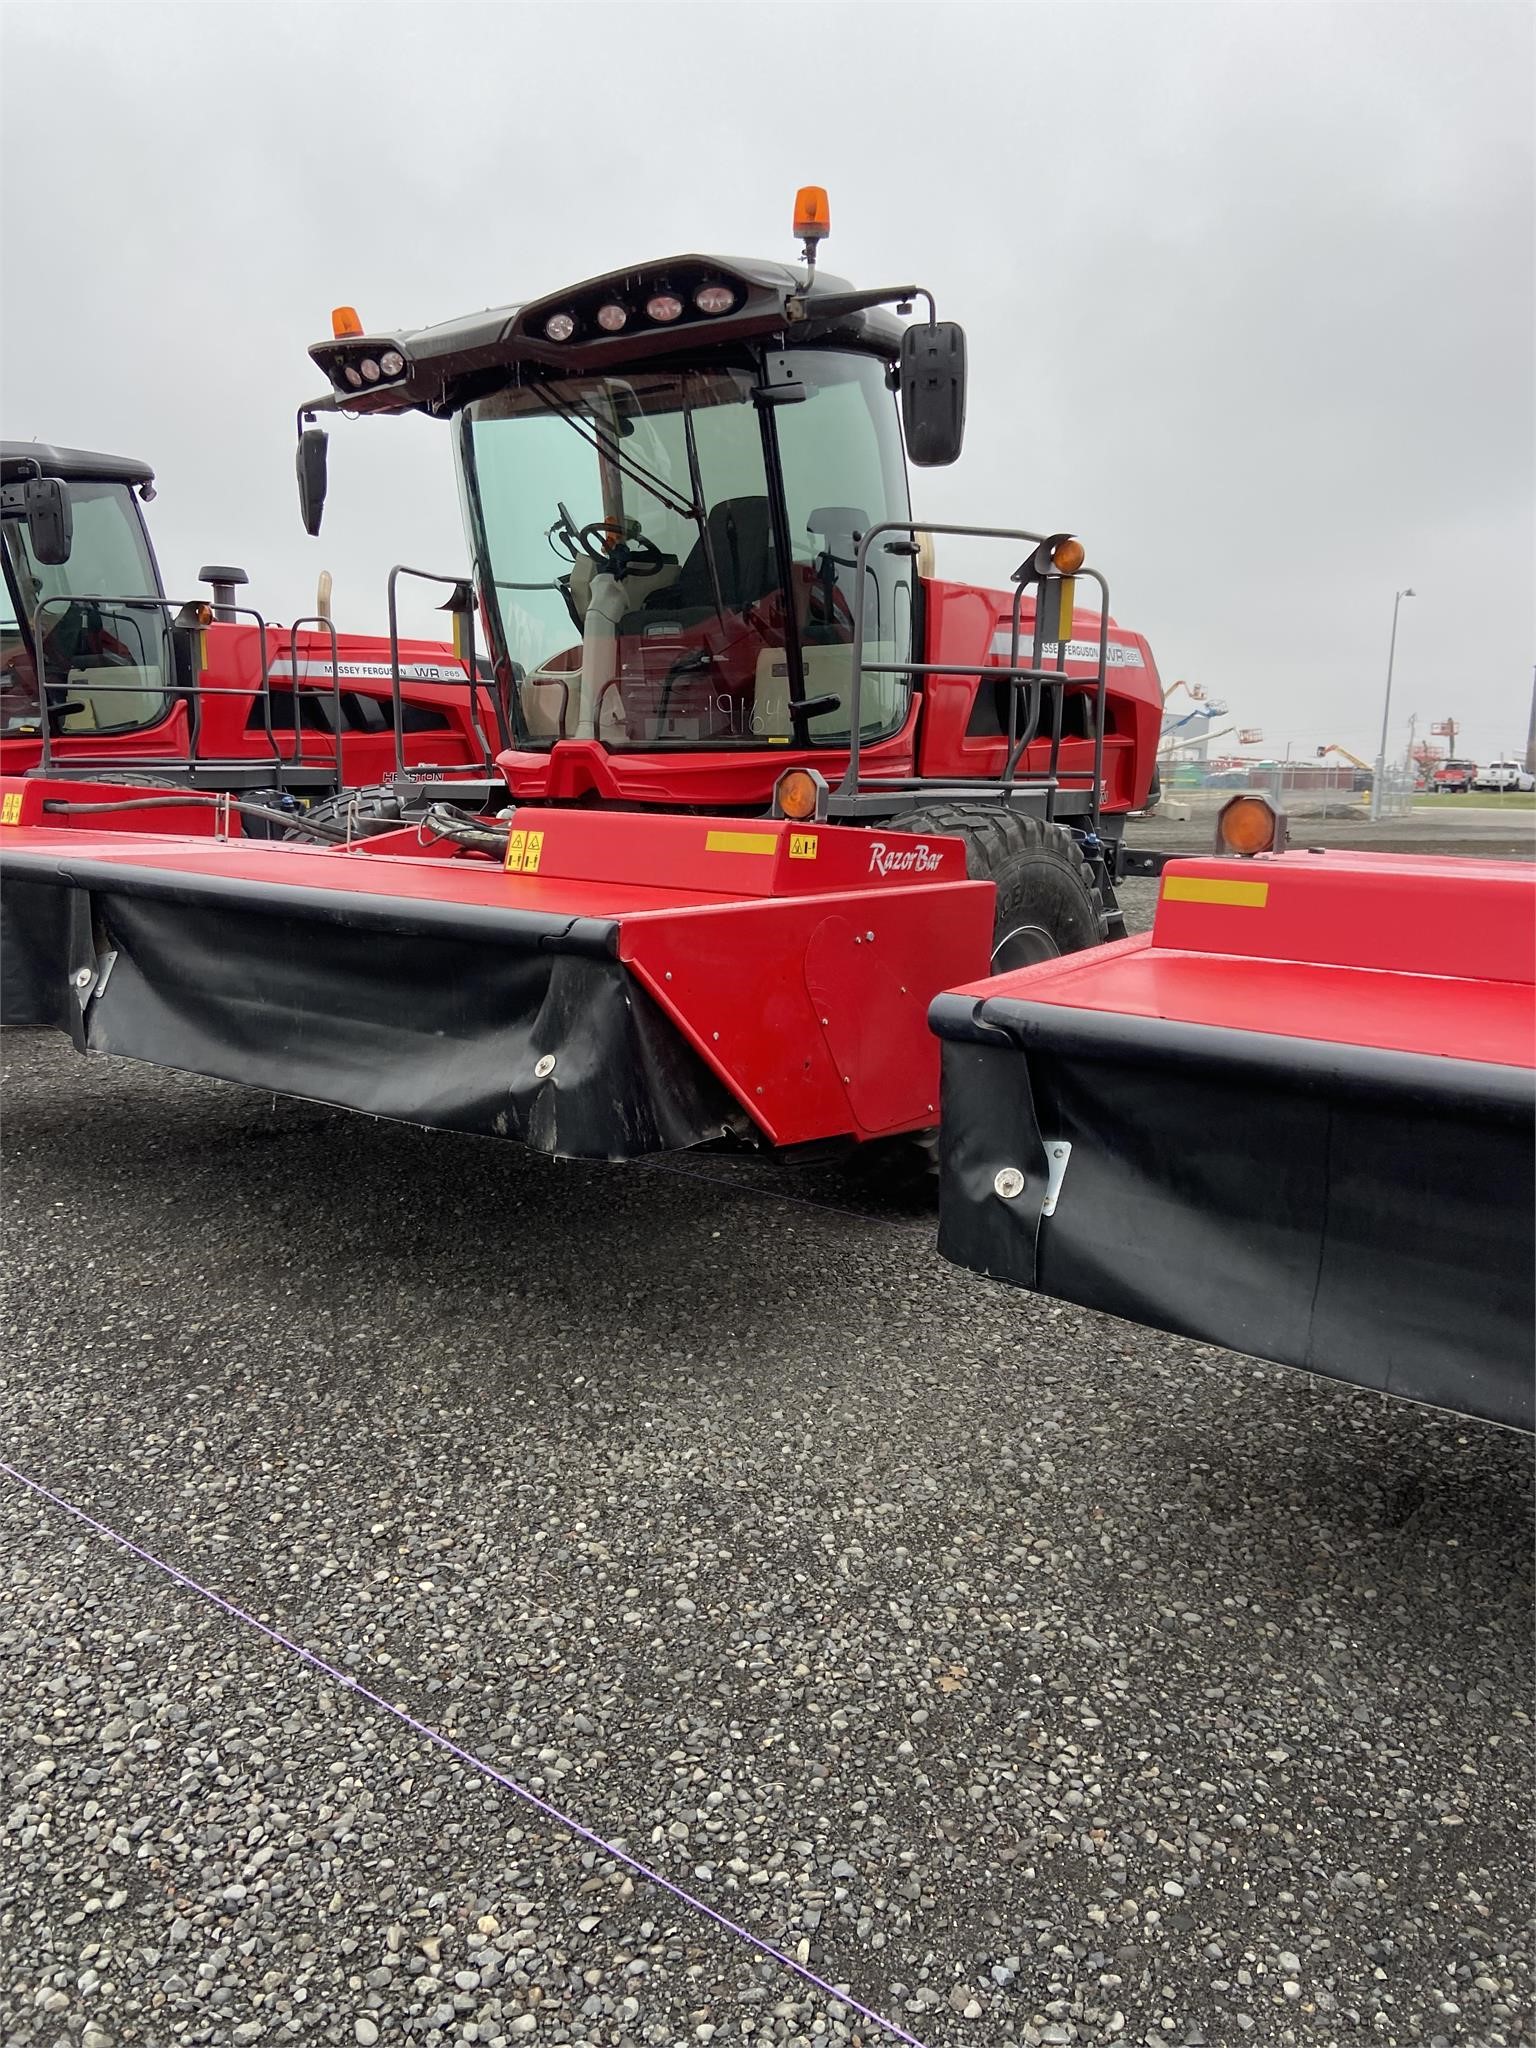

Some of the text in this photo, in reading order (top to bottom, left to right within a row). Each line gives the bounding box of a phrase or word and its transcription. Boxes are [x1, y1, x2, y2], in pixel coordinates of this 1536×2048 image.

[1063, 645, 1099, 658] FERGUSON
[1105, 648, 1124, 662] WR
[323, 665, 360, 675] MSSEY
[363, 667, 407, 676] FERGUSN
[414, 667, 440, 679] WR
